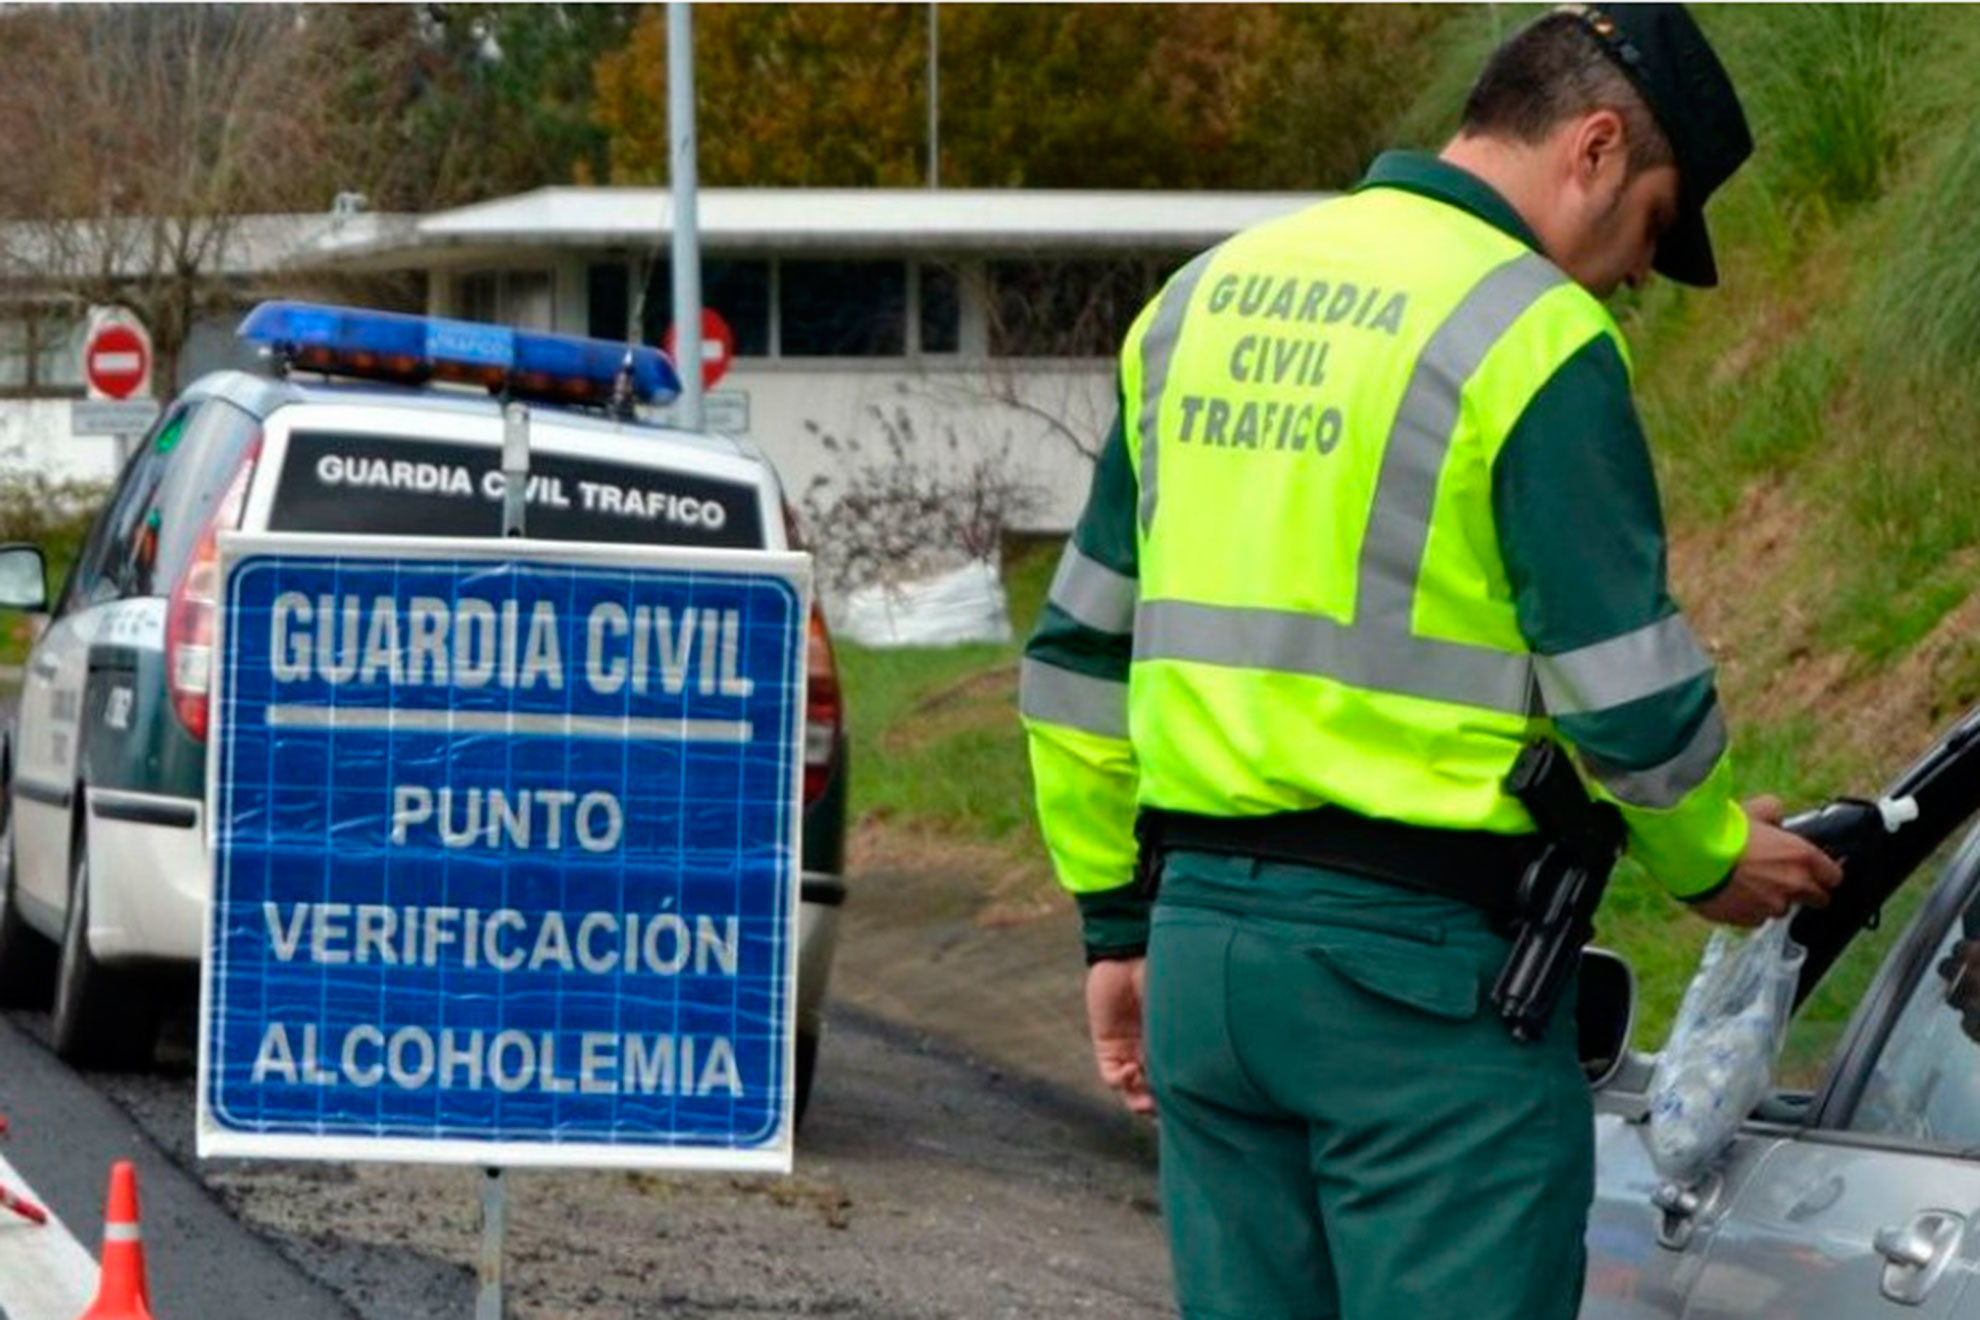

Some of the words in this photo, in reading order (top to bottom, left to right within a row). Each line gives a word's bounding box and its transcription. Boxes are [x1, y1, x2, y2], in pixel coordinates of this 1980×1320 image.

[1207, 273, 1408, 336] GUARDIA
[1229, 334, 1330, 386] CIVIL
[1178, 395, 1343, 455] TRAFICO
[317, 455, 474, 494] GUARDIA
[482, 470, 571, 507] CVIL
[579, 482, 727, 528] TRAFICO
[270, 591, 564, 689] GUARDIA
[585, 601, 754, 697] CIVIL
[390, 785, 624, 852] PUNTO
[263, 896, 739, 977] VERIFICACIÓN
[251, 1021, 744, 1098] ALCOHOLEMIA
